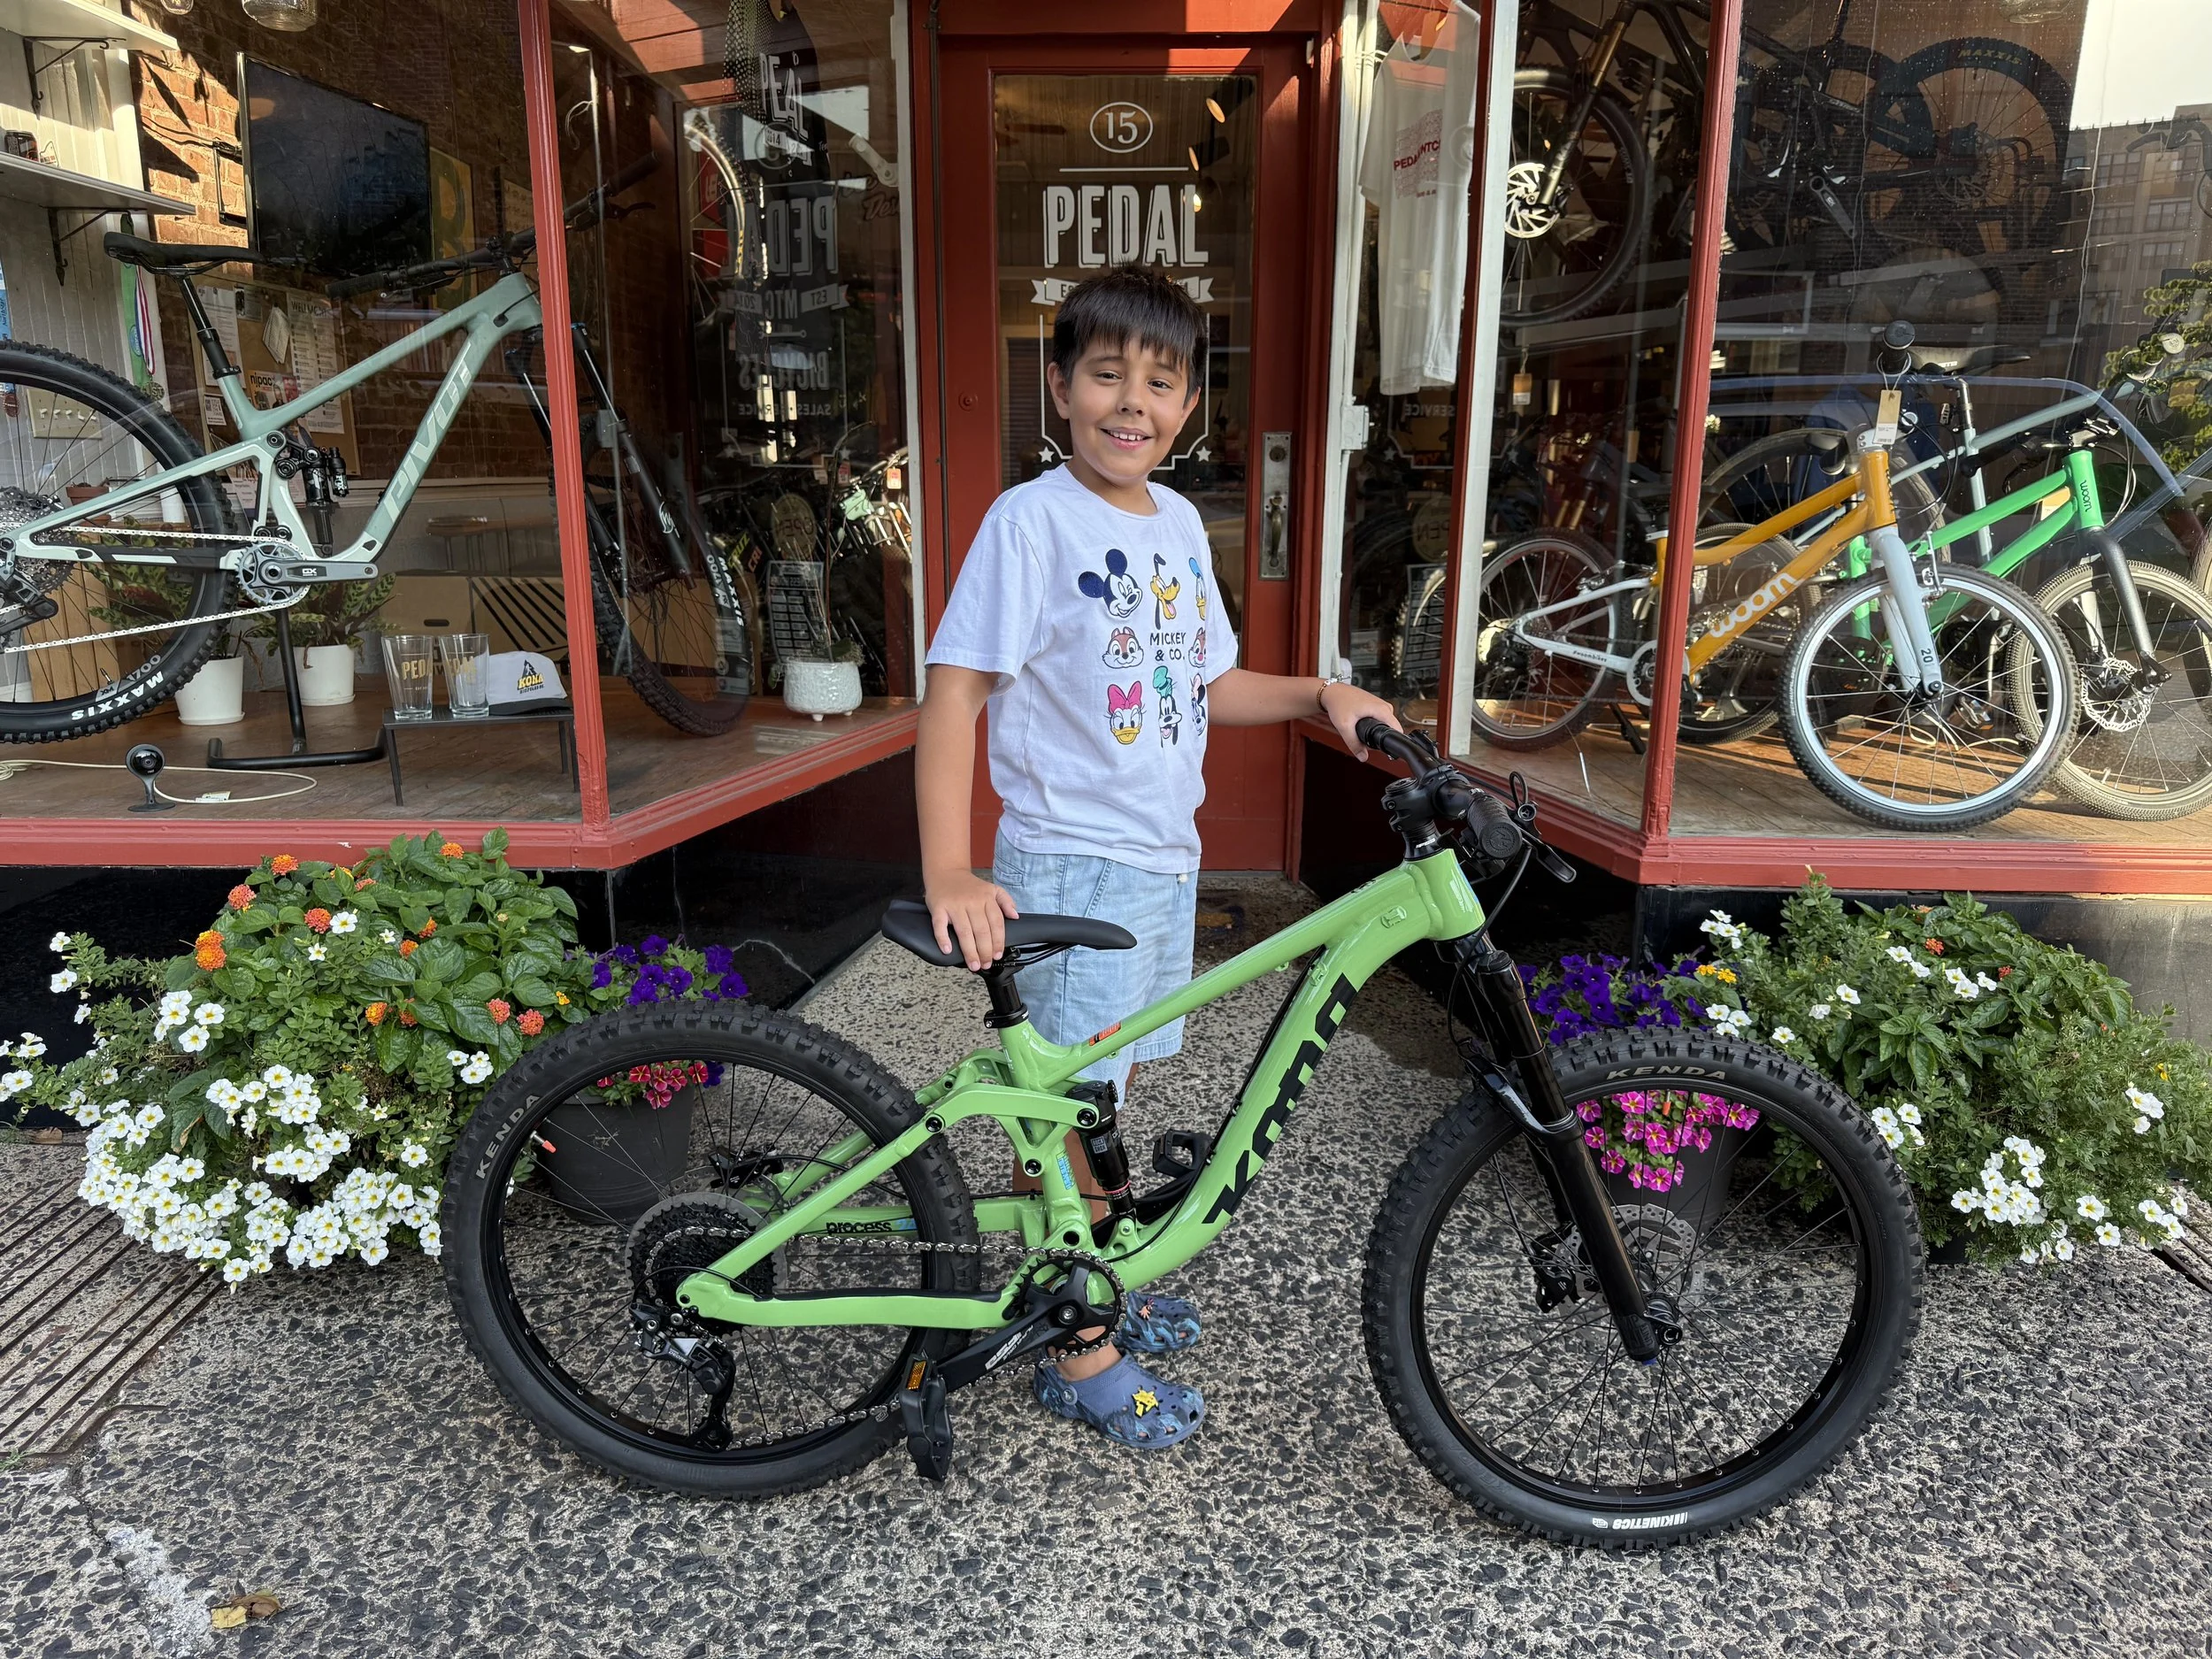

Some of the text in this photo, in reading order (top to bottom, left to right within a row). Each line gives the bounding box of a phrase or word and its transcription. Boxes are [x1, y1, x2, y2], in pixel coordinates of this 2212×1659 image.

[1104, 111, 1140, 145] 15
[1042, 184, 1210, 268] PEDAL
[383, 342, 472, 523] PIVOT
[2079, 479, 2093, 512] woom
[718, 556, 745, 626] MAXXIS
[1709, 572, 1798, 638] woom
[1150, 632, 1187, 646] MICKEY
[1155, 649, 1164, 662] &
[1921, 648, 1934, 664] 20
[72, 671, 165, 720] MAXXIS
[518, 674, 544, 689] KONA
[1606, 1065, 1726, 1080] KENDA
[475, 1094, 541, 1179] KENDA
[826, 1221, 893, 1235] process
